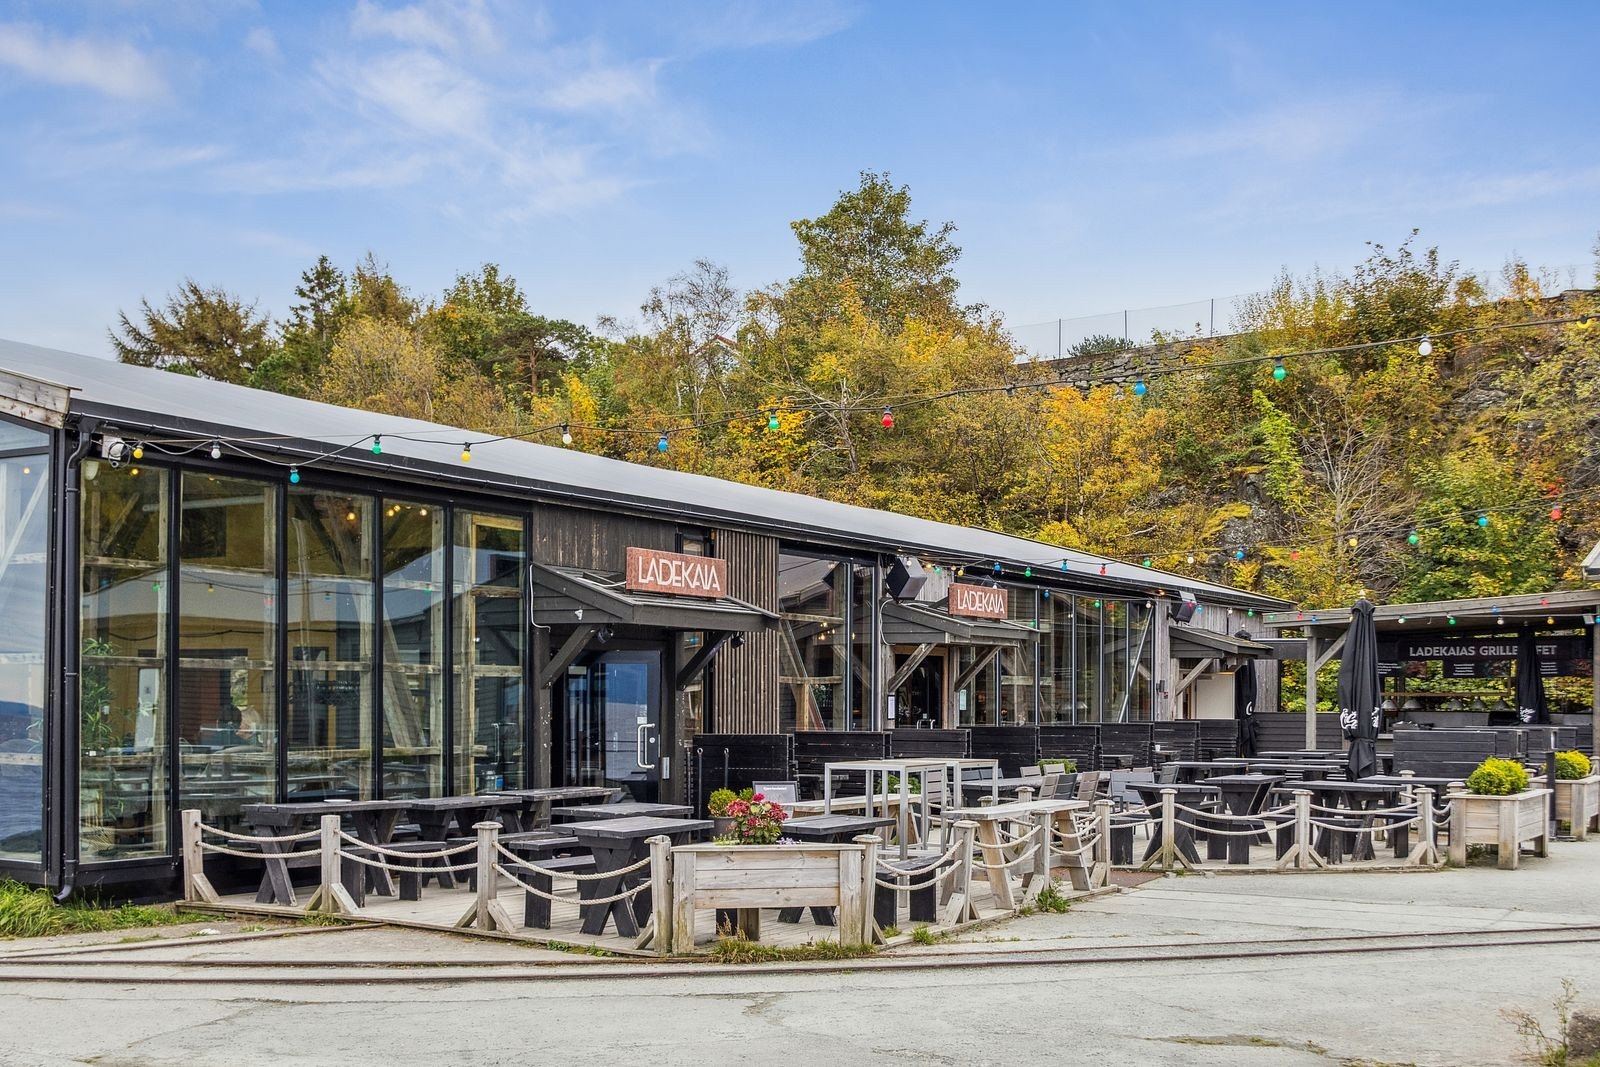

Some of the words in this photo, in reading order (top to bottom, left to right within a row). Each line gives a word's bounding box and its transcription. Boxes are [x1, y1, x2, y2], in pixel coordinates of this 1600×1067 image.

[638, 555, 721, 592] LADEKAIA
[957, 589, 1005, 614] LADEKAIA
[1409, 646, 1475, 656] LADEKAIAS
[1479, 645, 1557, 656] GRILLFET
